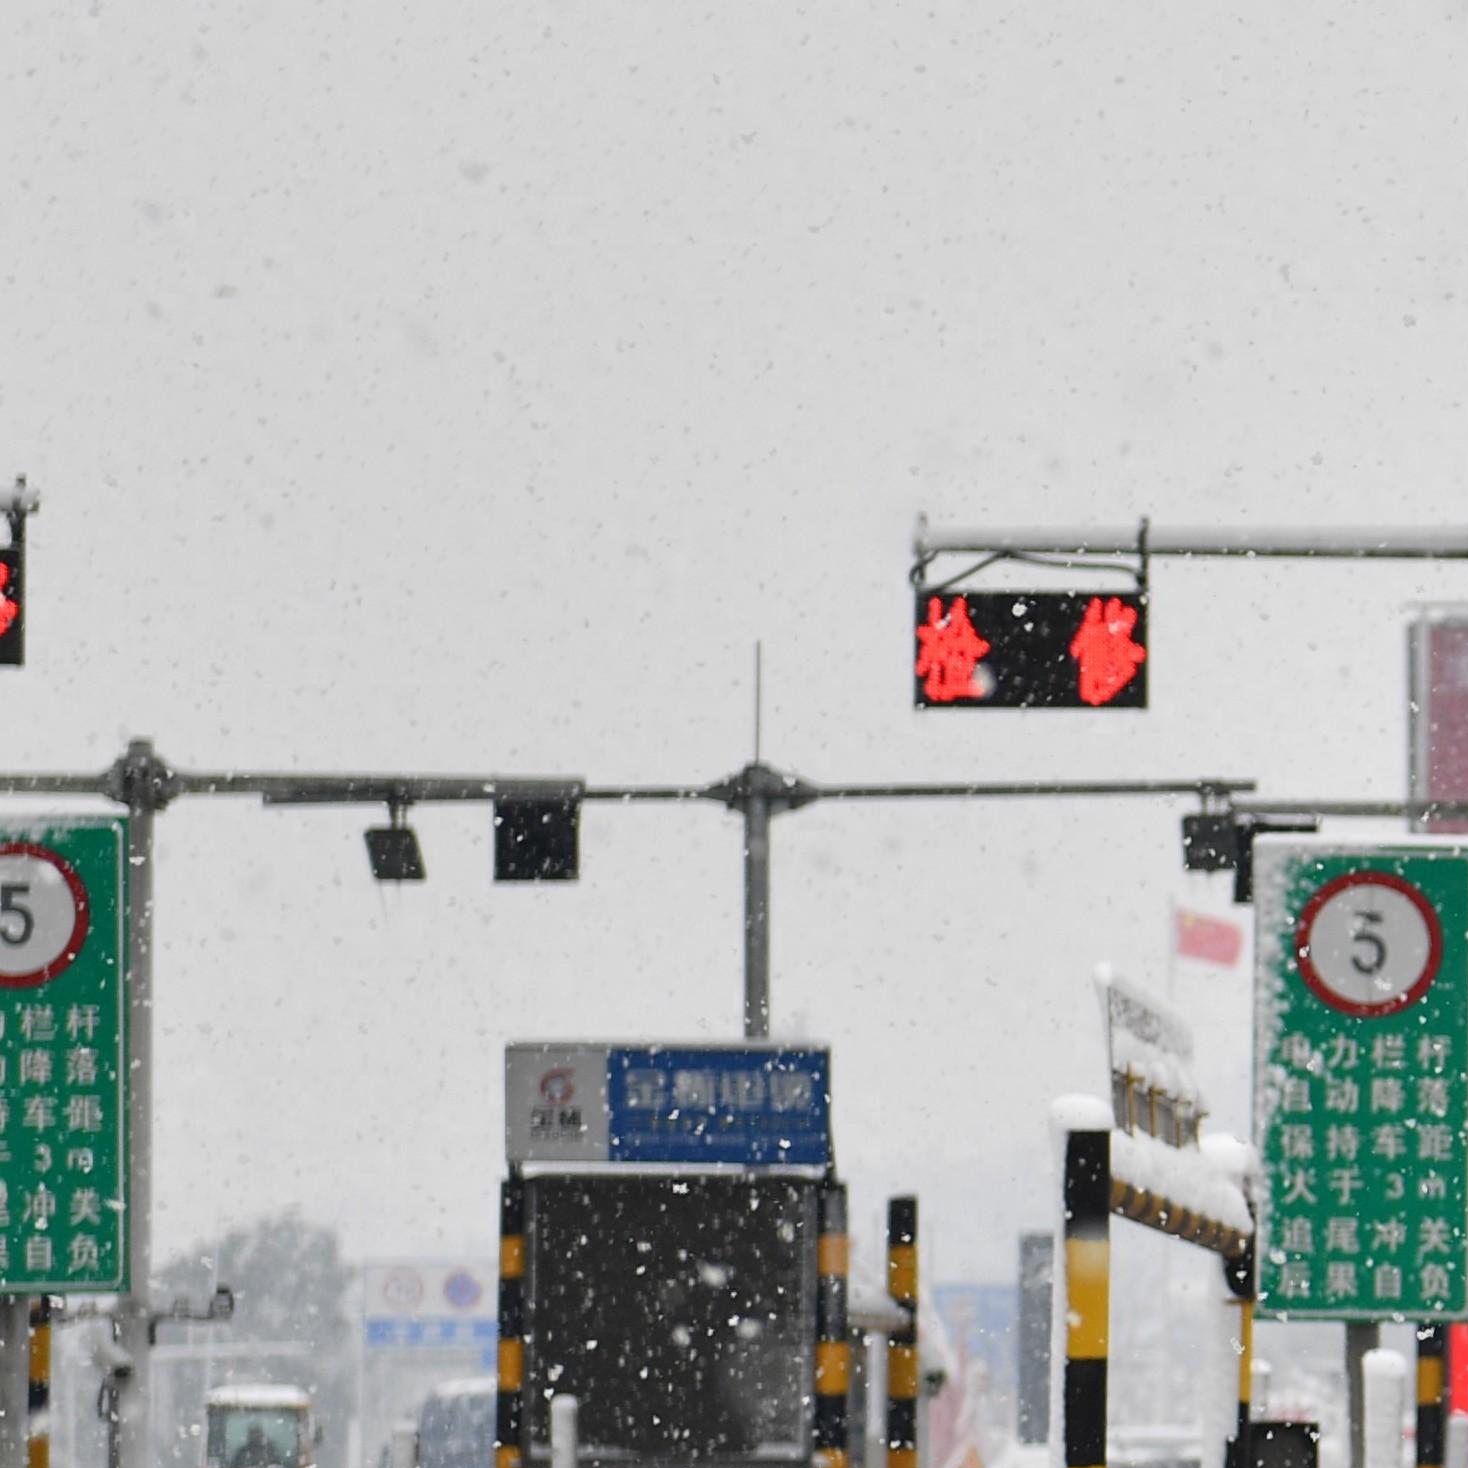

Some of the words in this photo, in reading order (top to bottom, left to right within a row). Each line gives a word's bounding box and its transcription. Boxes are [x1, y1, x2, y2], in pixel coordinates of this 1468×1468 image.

[0, 885, 34, 945] 5
[1351, 911, 1387, 975] 5
[0, 1003, 99, 1041] 栏杆
[0, 1048, 98, 1086] 降落
[1281, 1032, 1452, 1069] 电力栏杆
[0, 1096, 101, 1133] 车距
[1281, 1078, 1452, 1117] 自动降落
[1281, 1122, 1453, 1161] 保持车距
[0, 1233, 98, 1273] 自负
[1279, 1261, 1452, 1300] 后果自负
